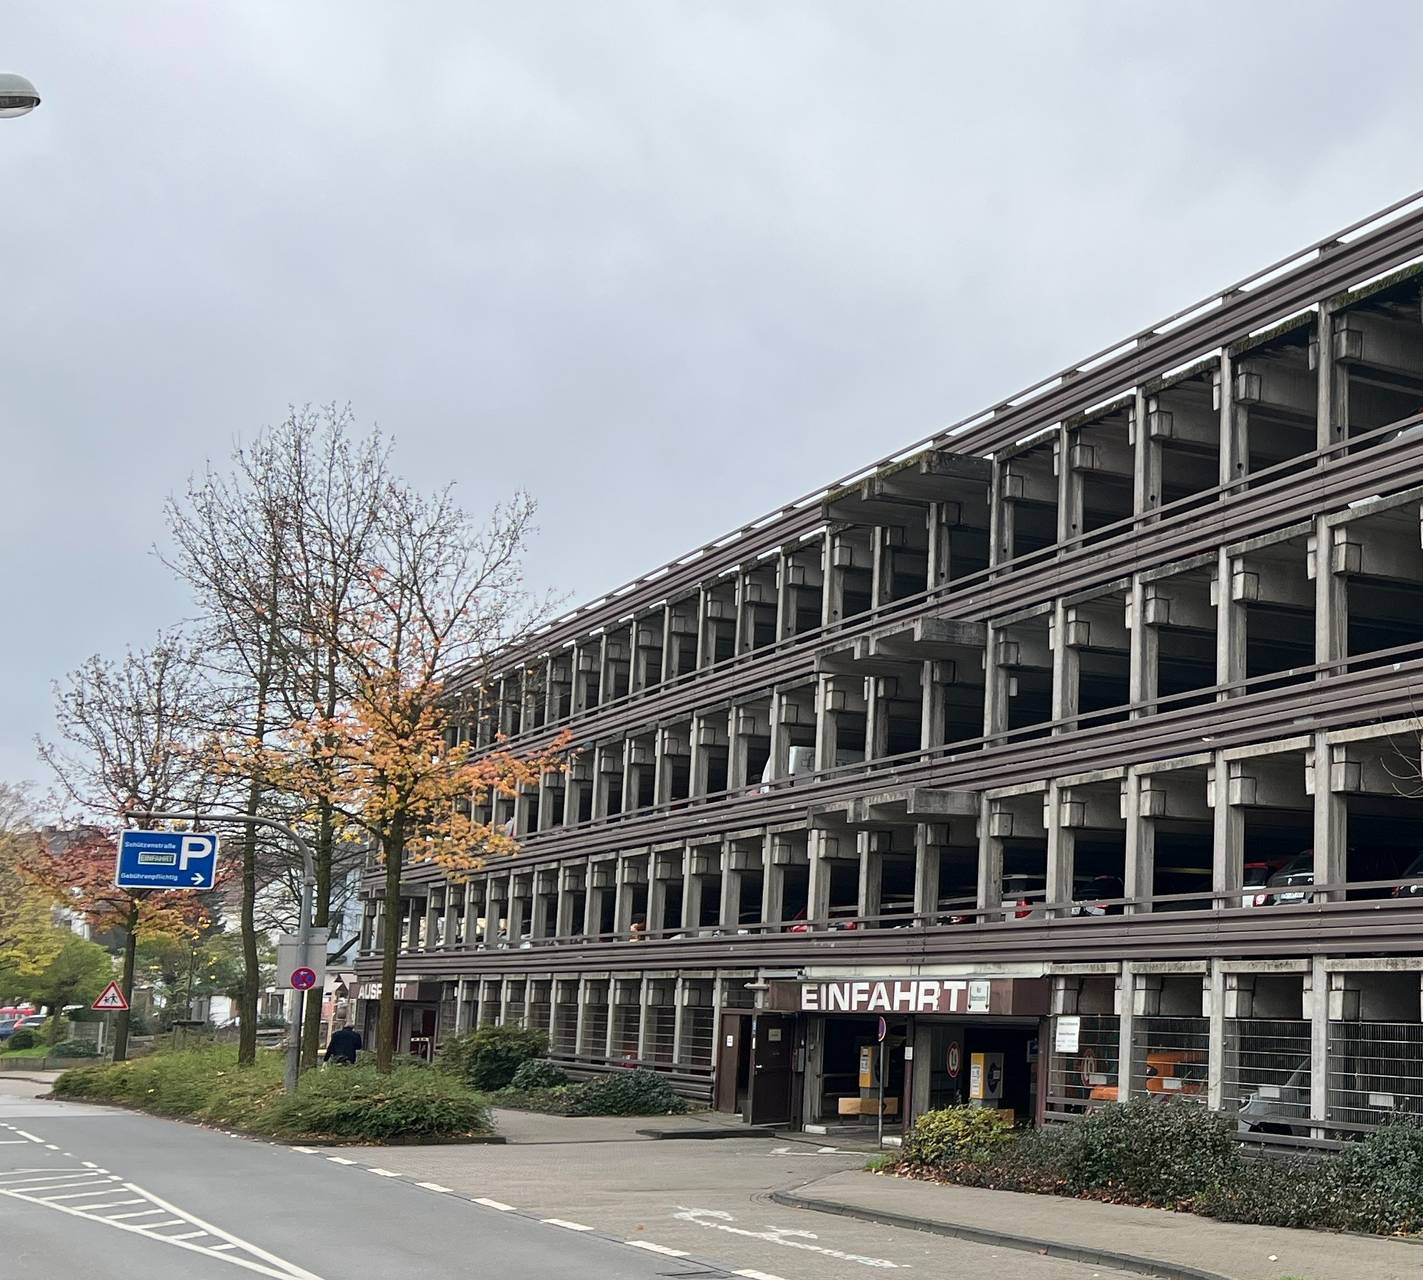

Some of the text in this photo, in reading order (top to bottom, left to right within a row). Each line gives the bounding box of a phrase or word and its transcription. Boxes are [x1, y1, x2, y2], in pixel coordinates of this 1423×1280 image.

[124, 841, 176, 849] Schützenstraße
[179, 836, 212, 870] P
[120, 872, 178, 881] Gebührenpflichtig
[358, 983, 407, 999] AUSFRT
[801, 981, 966, 1011] EINFAHRT
